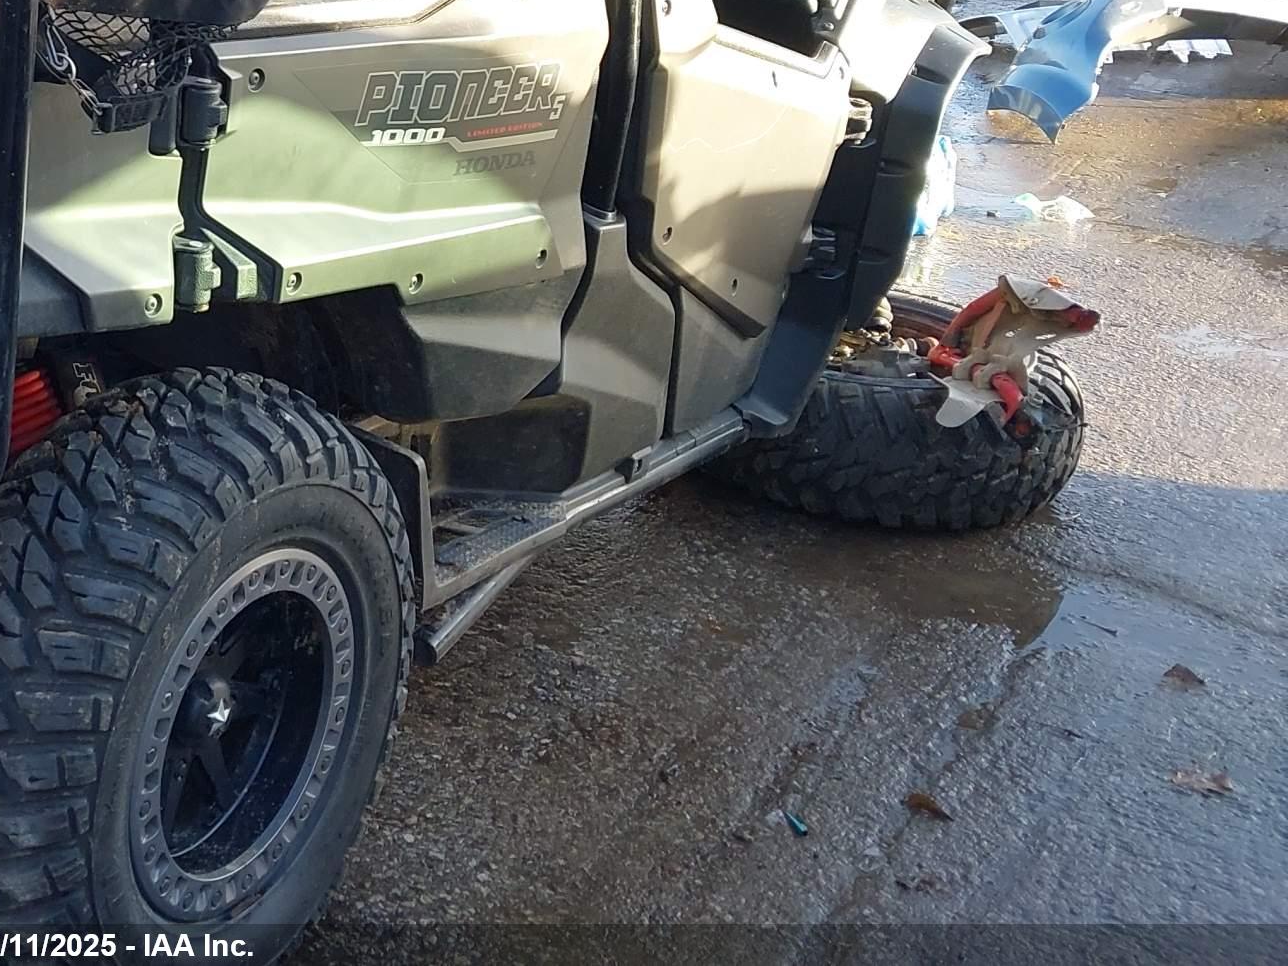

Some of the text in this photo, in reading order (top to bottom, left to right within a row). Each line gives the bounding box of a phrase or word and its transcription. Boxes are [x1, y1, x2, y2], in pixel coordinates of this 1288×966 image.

[354, 61, 561, 127] PIONEER
[371, 127, 446, 146] 1000
[467, 126, 507, 138] LIMITED
[454, 150, 536, 176] HONDA
